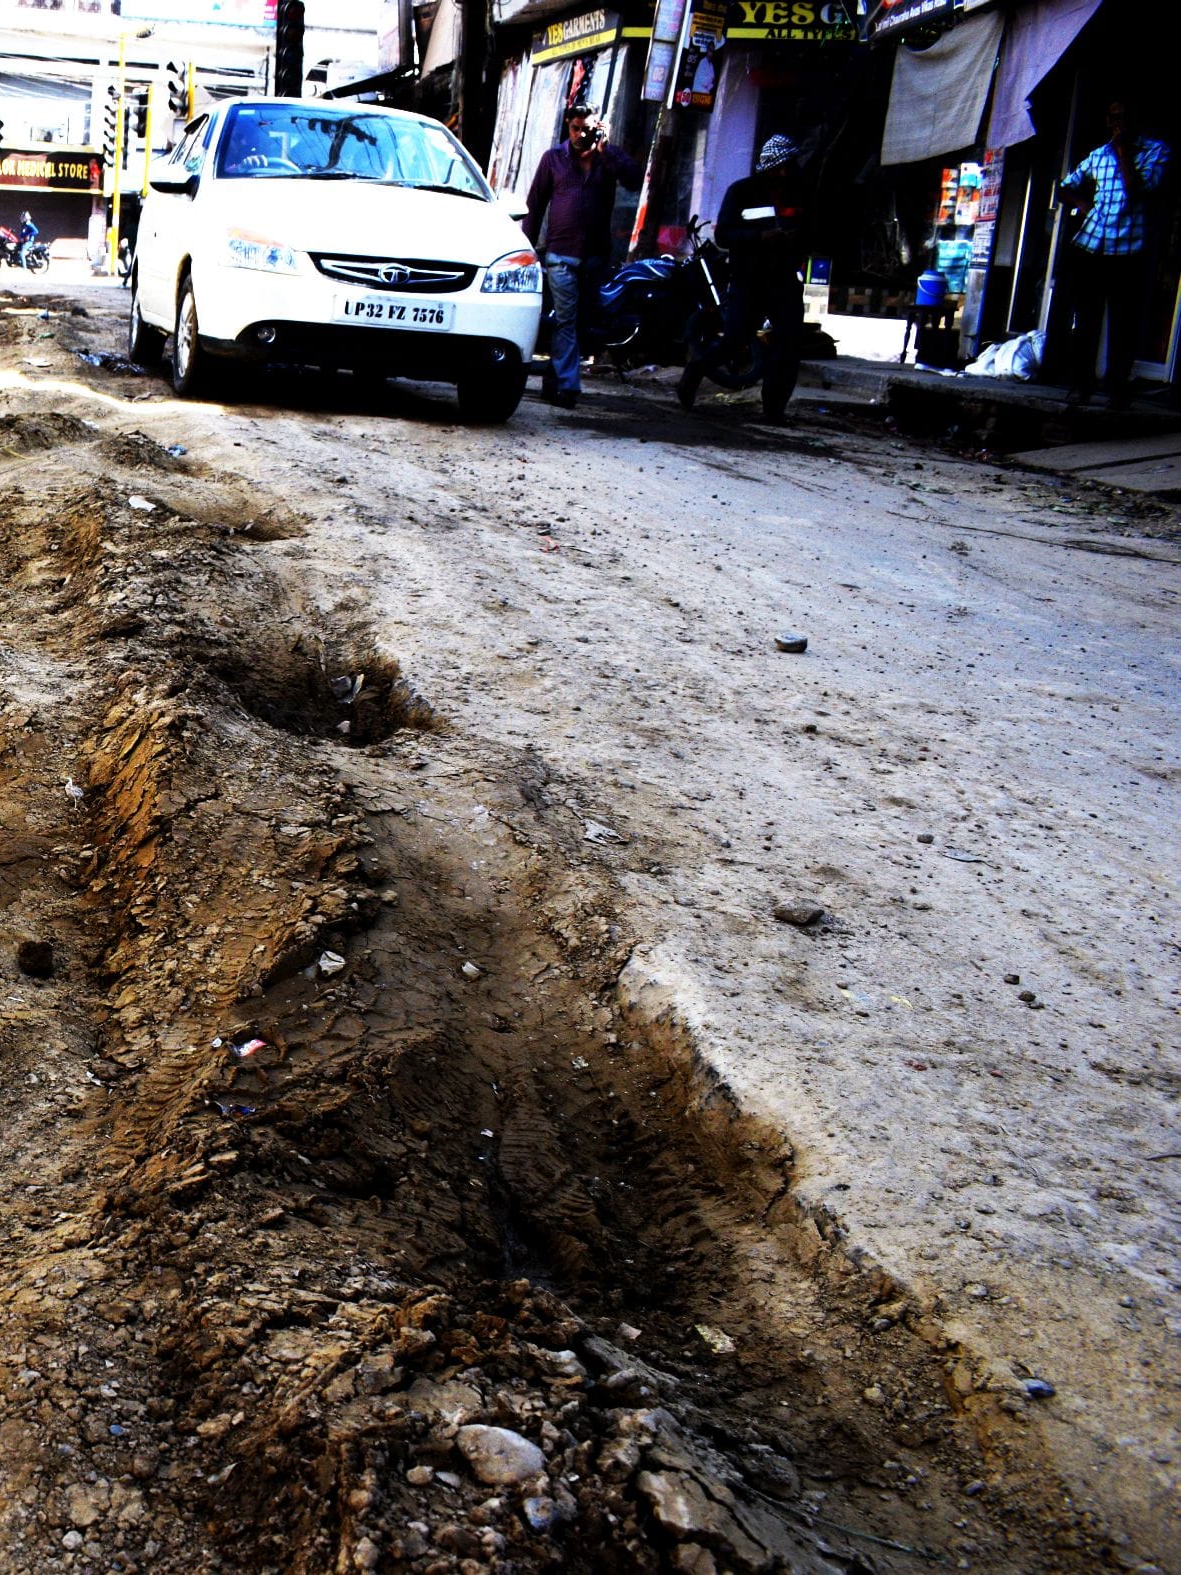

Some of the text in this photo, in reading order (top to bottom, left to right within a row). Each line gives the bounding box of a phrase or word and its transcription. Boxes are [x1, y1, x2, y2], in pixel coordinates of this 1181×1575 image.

[739, 2, 815, 24] YES
[548, 8, 606, 46] YES GARMENTS
[765, 28, 797, 39] ALL
[17, 159, 56, 179] MEDICAL
[58, 162, 88, 179] STORE
[344, 299, 444, 324] UP32 FZ 7576
